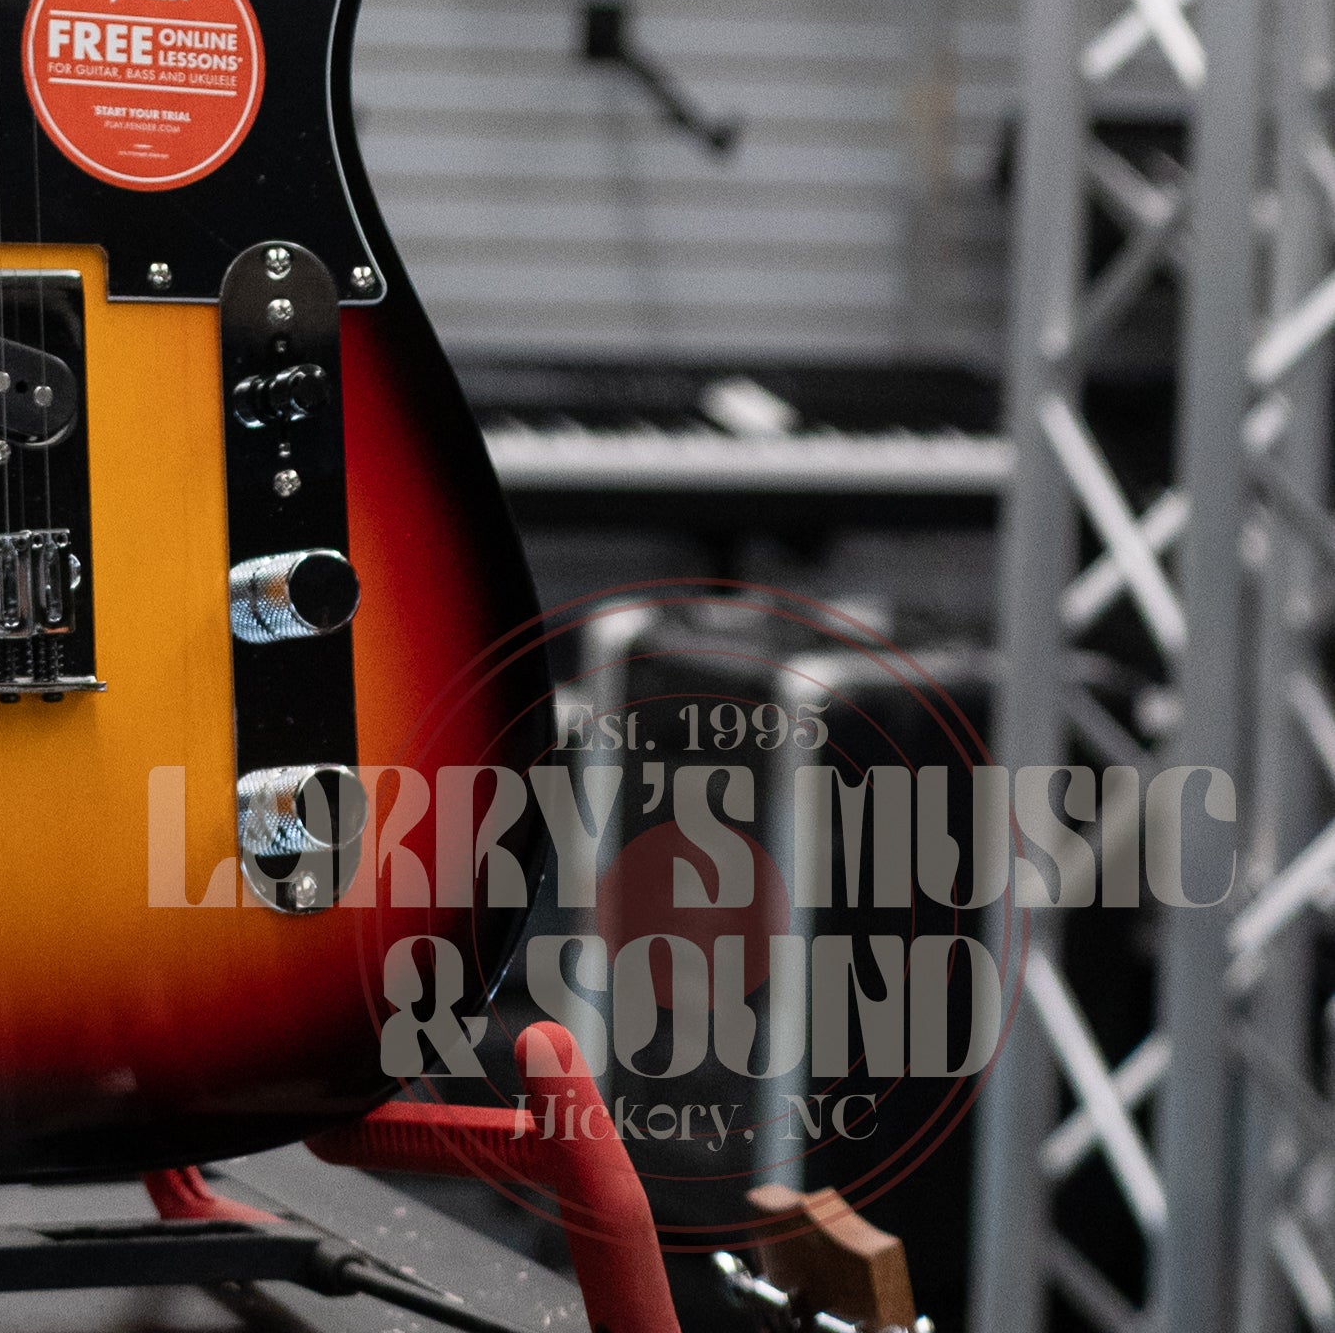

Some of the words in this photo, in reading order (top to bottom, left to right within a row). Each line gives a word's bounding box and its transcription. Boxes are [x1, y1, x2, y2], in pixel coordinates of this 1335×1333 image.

[47, 18, 154, 66] FREE
[157, 28, 238, 52] ONLINE
[47, 61, 72, 75] FOR
[75, 63, 122, 79] GUITAR,
[126, 67, 156, 82] BASS
[159, 70, 186, 83] AND
[189, 73, 238, 88] UKULELE
[129, 107, 160, 120] YOUR
